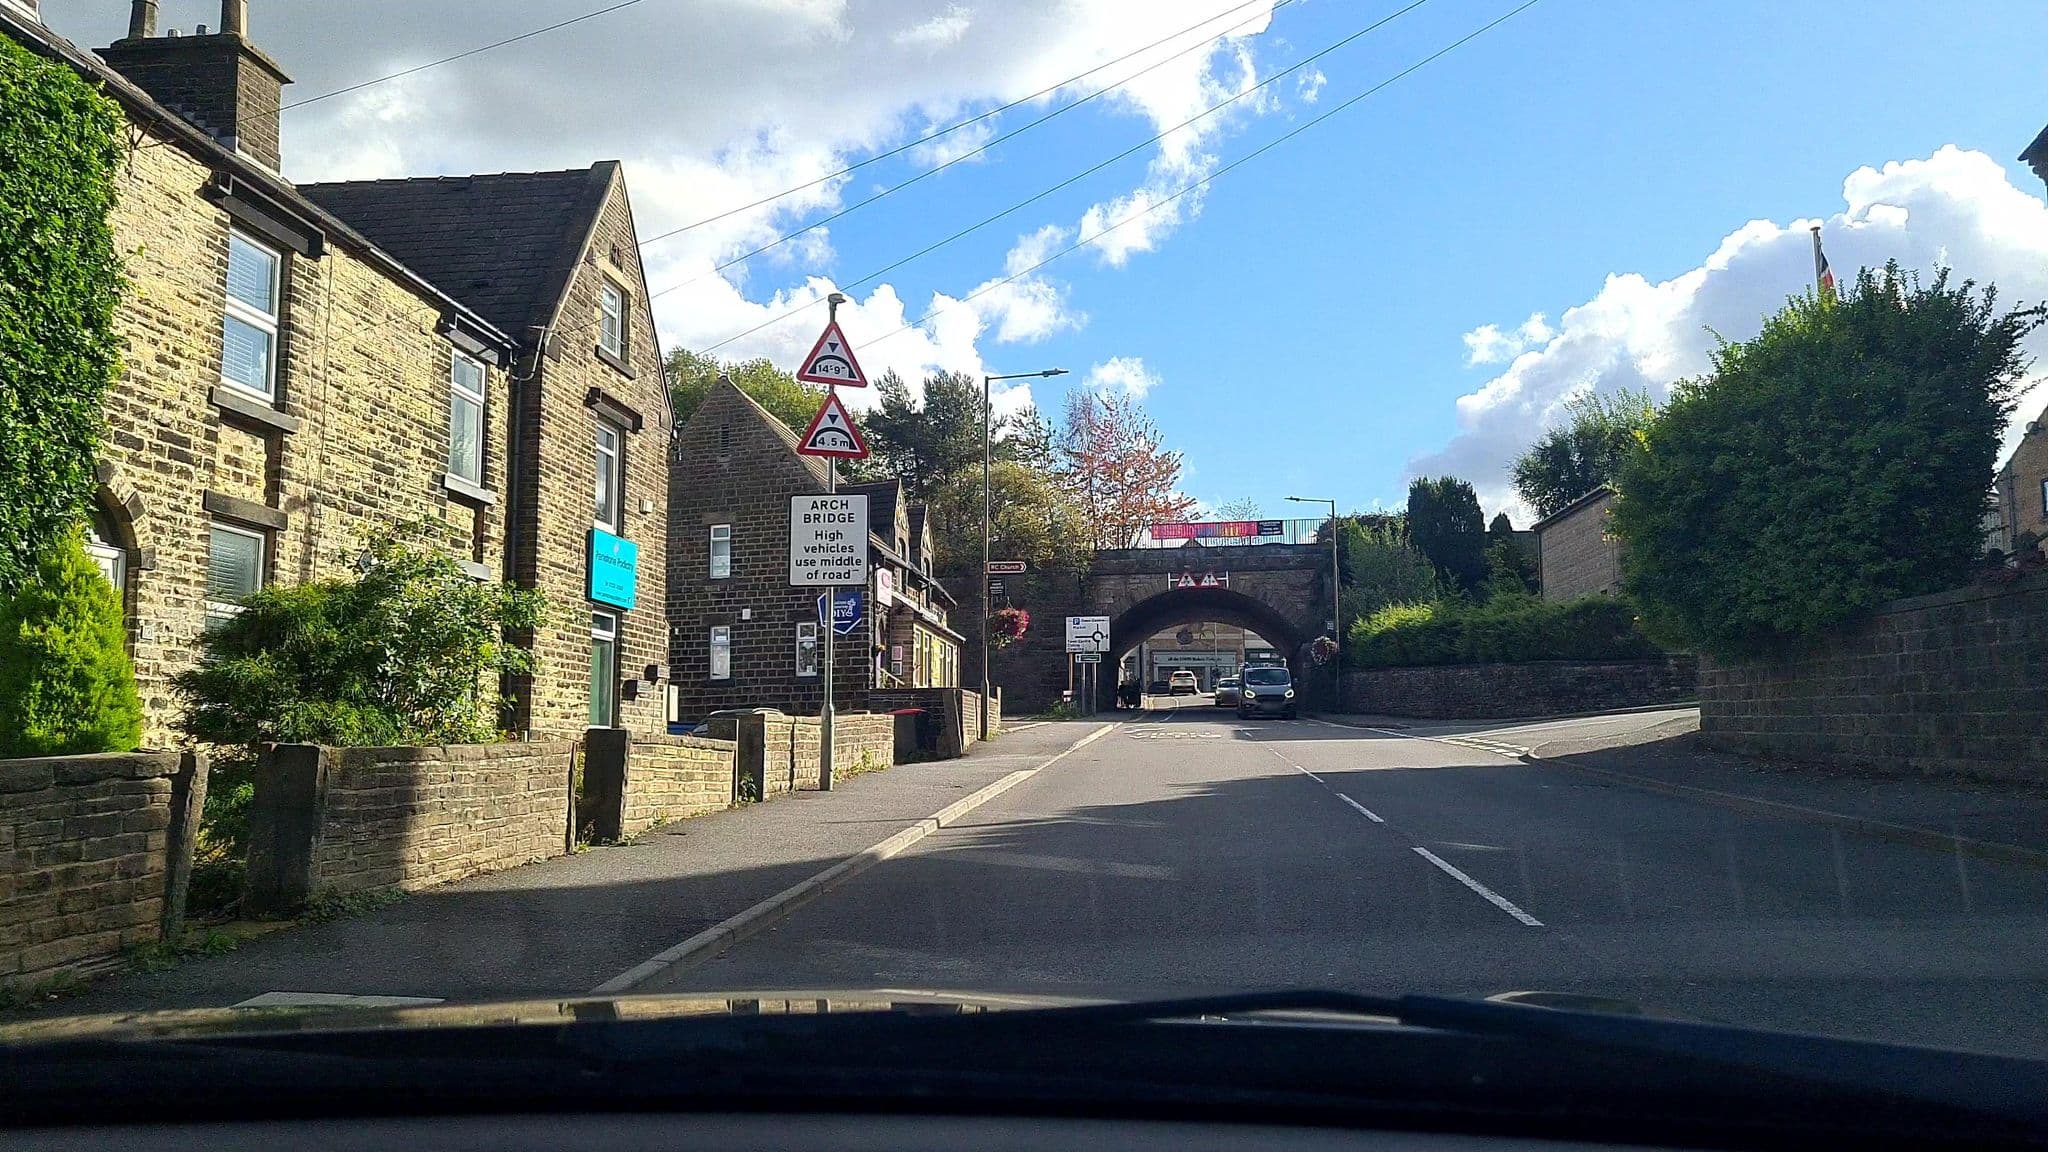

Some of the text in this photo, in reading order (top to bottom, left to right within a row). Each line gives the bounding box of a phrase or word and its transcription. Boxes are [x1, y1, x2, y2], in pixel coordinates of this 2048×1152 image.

[810, 499, 849, 511] ARCH
[803, 512, 856, 524] BRIDGE
[814, 529, 844, 542] High
[803, 543, 855, 554] vehicles
[795, 555, 863, 567] use middle
[806, 569, 851, 580] of road
